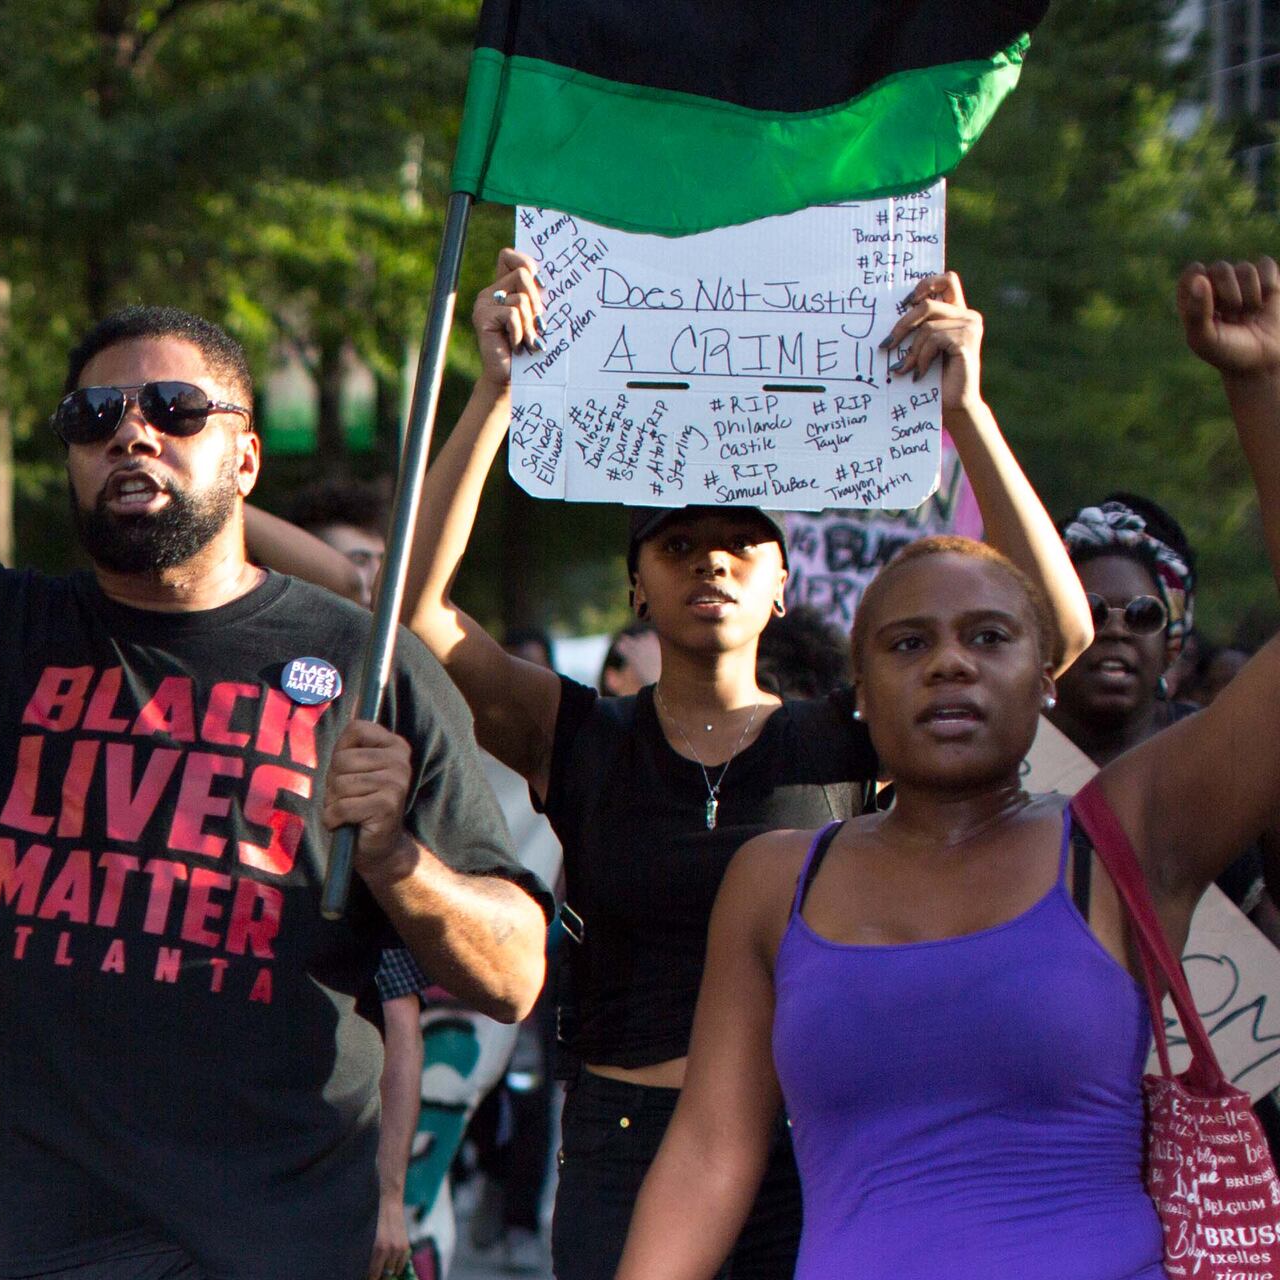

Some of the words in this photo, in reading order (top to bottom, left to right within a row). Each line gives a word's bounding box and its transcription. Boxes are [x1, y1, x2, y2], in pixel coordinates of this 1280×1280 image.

[596, 266, 684, 309] Does
[695, 276, 761, 313] Not
[762, 280, 878, 339] Justify
[603, 324, 638, 372] A
[891, 420, 941, 441] Sandra
[888, 439, 931, 460] Bland
[288, 670, 335, 690] LIVES
[291, 660, 338, 683] BLACK
[285, 679, 333, 699] MATTER
[21, 664, 334, 770] BLACK
